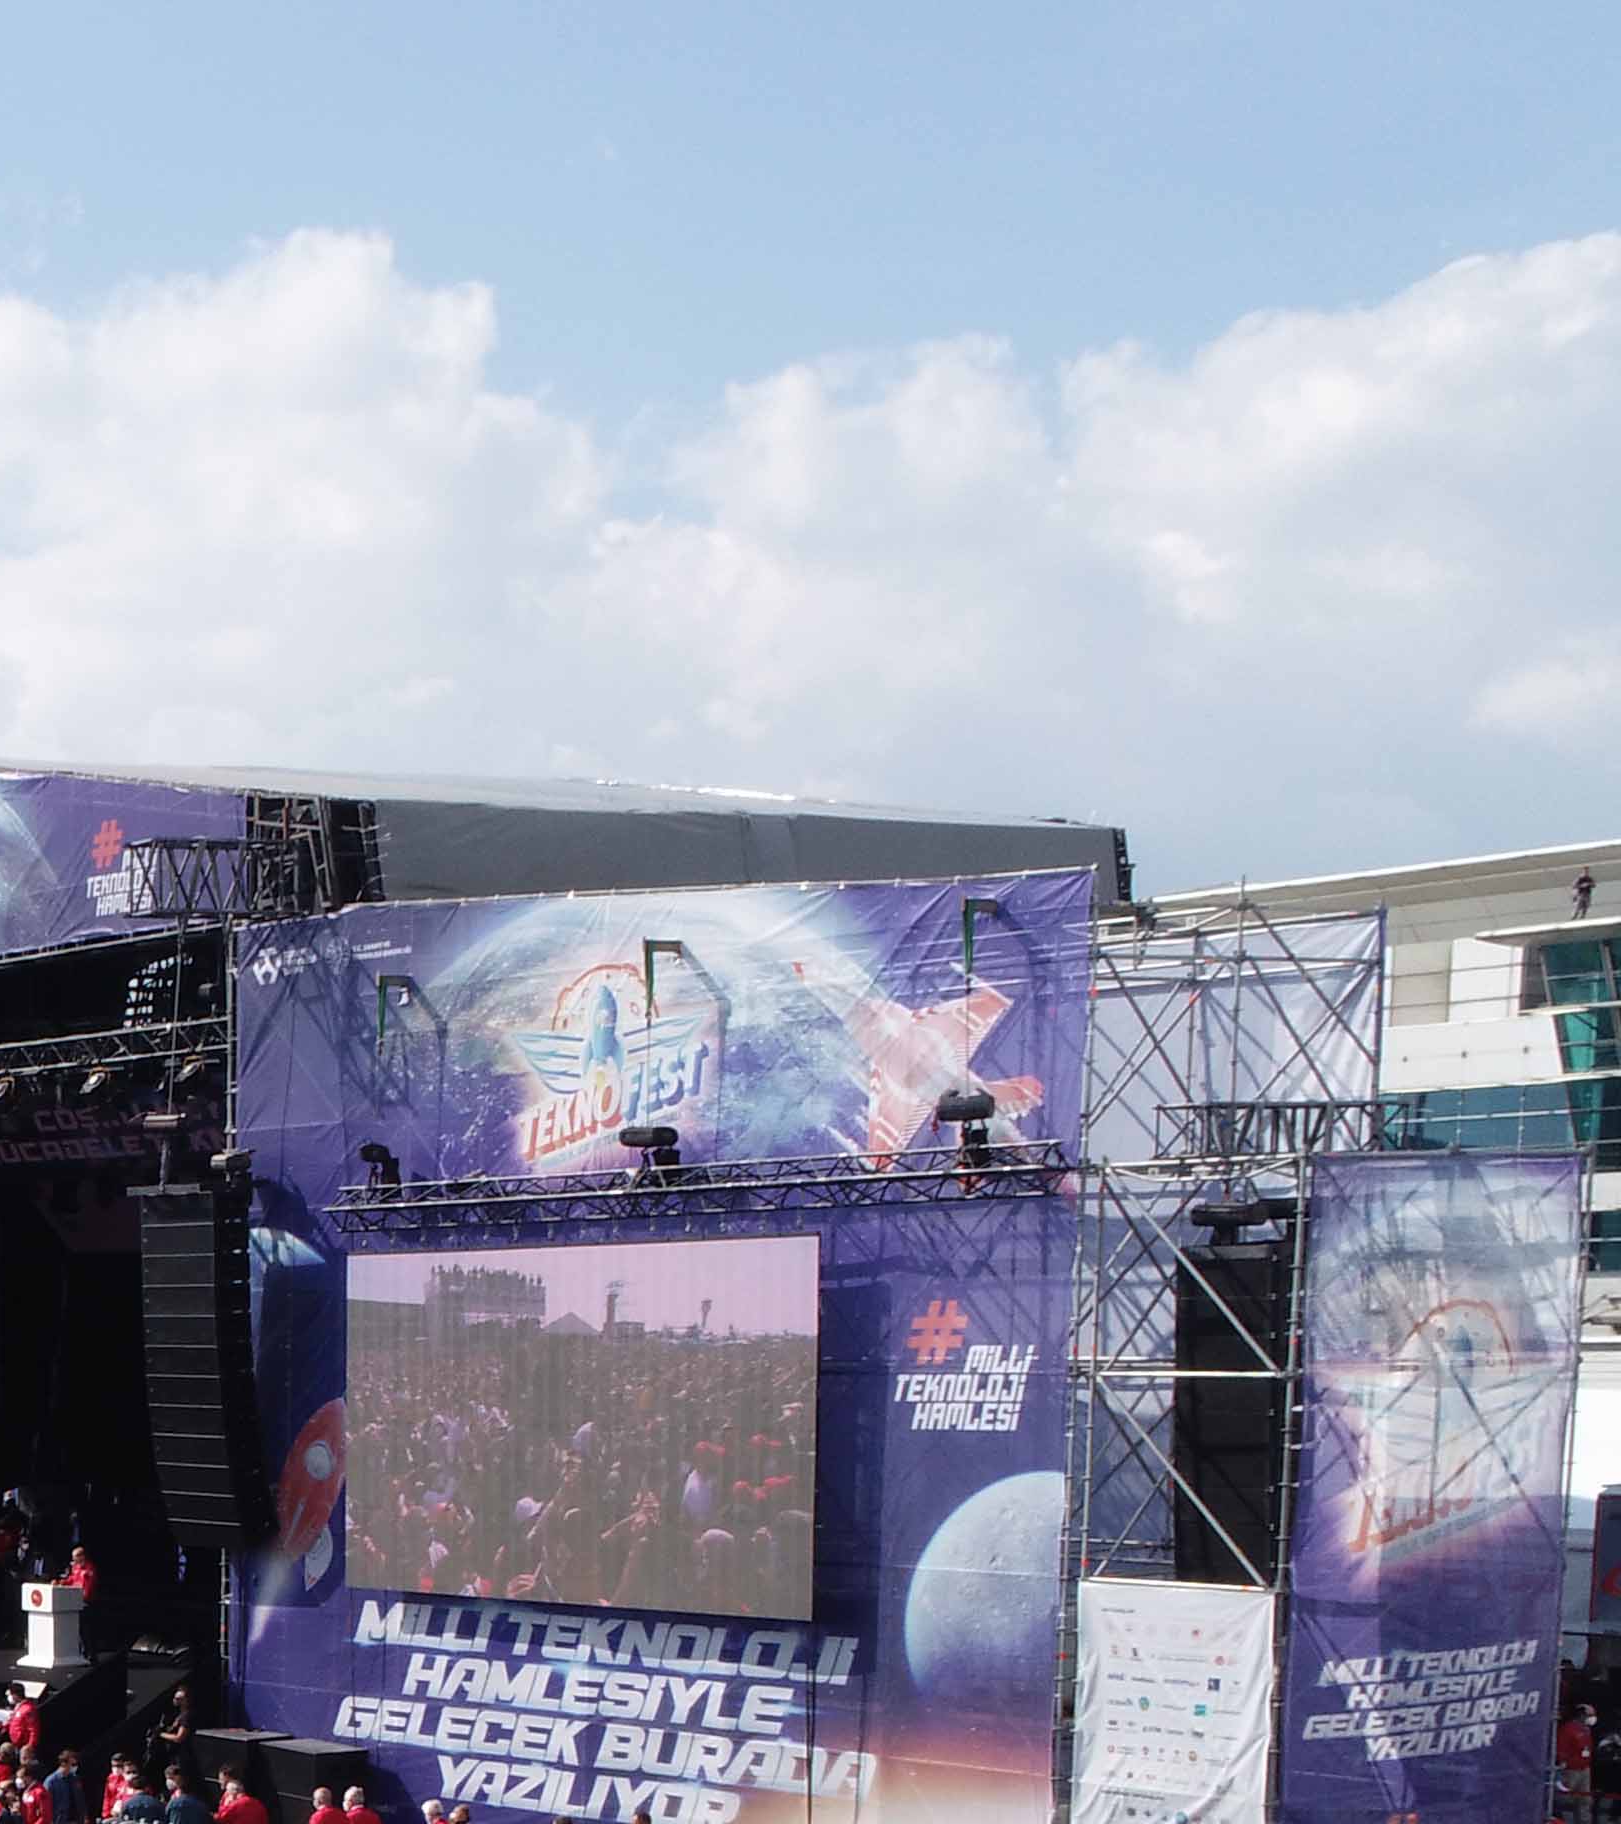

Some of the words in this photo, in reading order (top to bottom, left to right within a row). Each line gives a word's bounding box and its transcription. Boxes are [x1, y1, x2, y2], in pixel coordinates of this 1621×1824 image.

[520, 1043, 710, 1161] TEKNOFEST
[333, 1696, 590, 1767] GELECEK
[594, 1723, 877, 1799] BURADA
[1303, 1703, 1442, 1741] GELECEK
[1443, 1691, 1540, 1729] BURADA
[1365, 1724, 1497, 1761] YAZILIYOR
